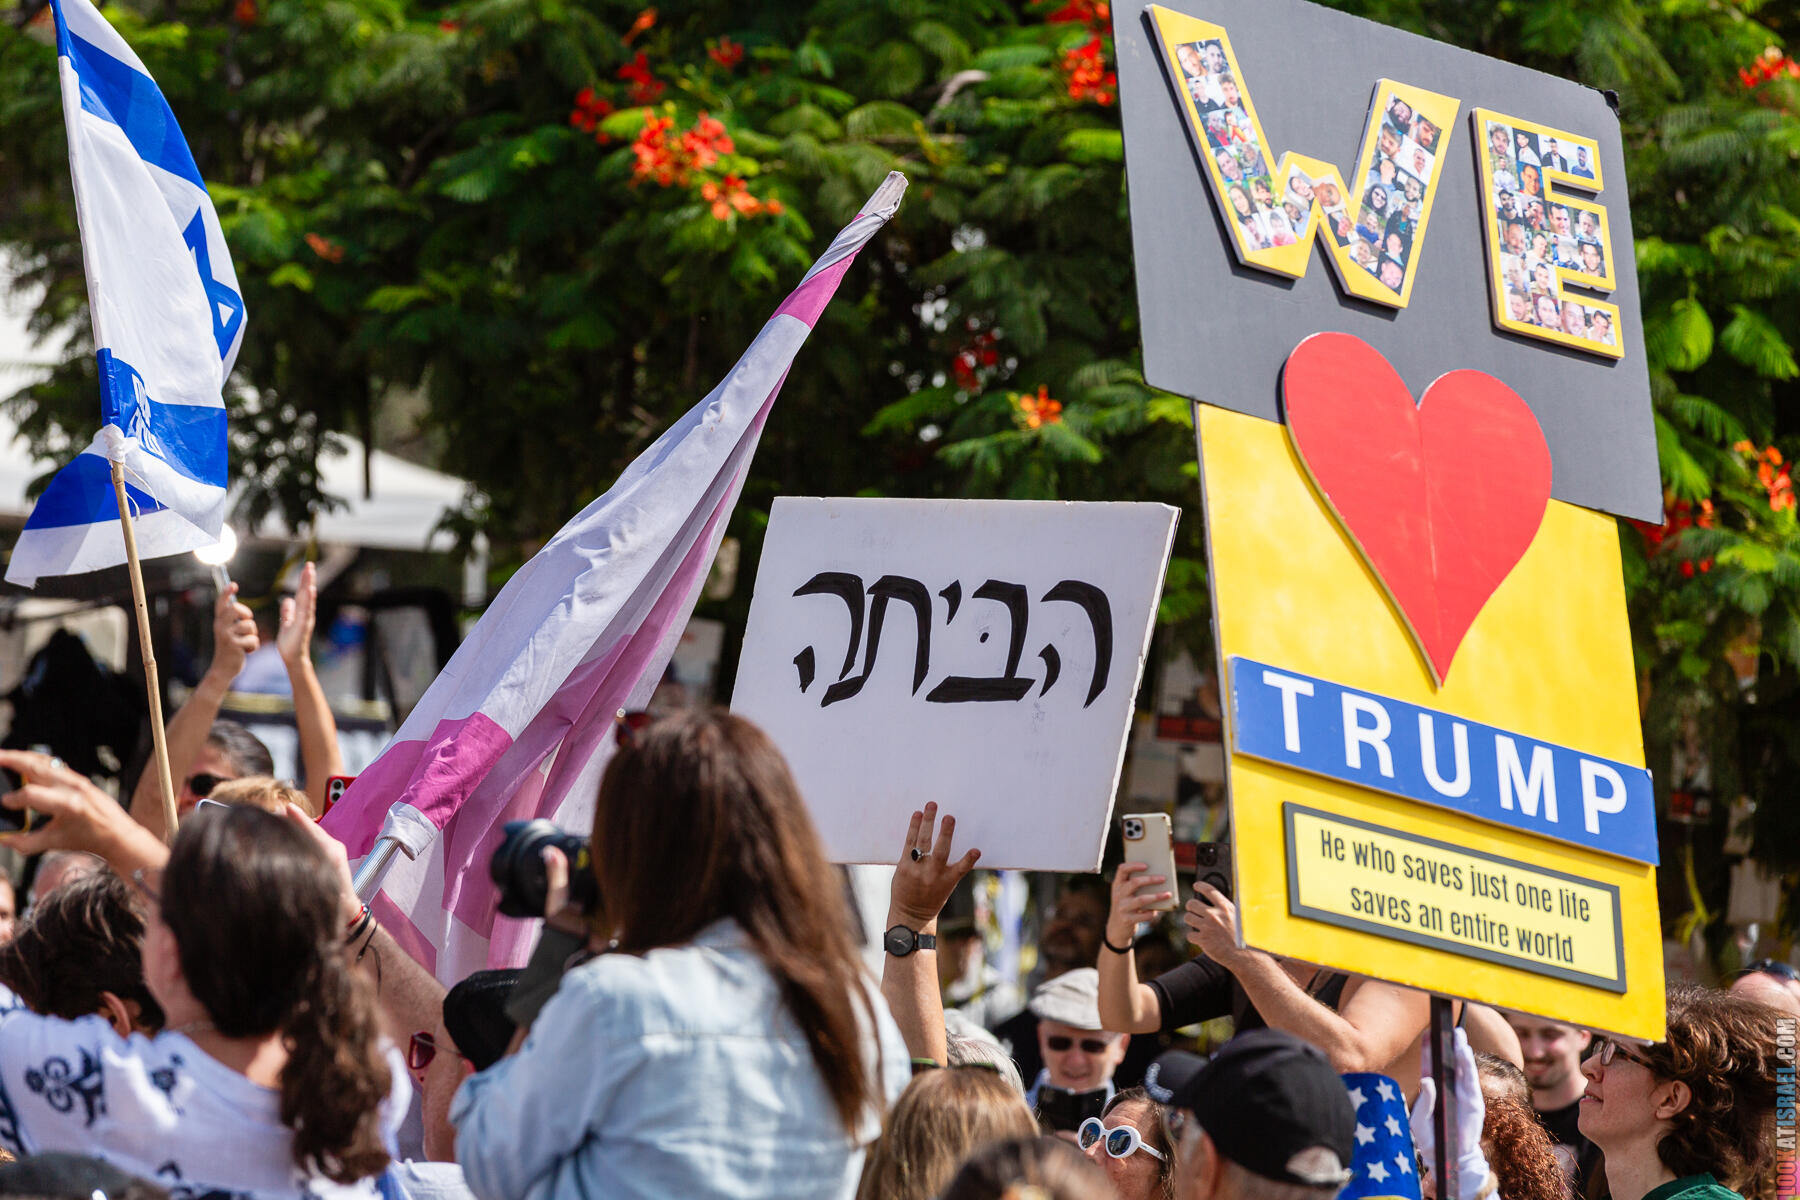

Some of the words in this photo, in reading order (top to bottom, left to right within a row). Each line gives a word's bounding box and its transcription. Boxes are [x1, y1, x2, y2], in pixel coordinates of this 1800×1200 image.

[1146, 4, 1624, 359] WE
[1262, 671, 1628, 835] TRUMP
[1320, 829, 1345, 861] He
[1353, 841, 1395, 873] who
[1403, 853, 1463, 891] saves
[1470, 865, 1509, 902] just
[1516, 881, 1551, 912] one
[1559, 888, 1590, 922] life
[1351, 887, 1411, 923] saves
[1419, 903, 1443, 932] an
[1451, 911, 1509, 948] entire
[1517, 927, 1573, 964] world
